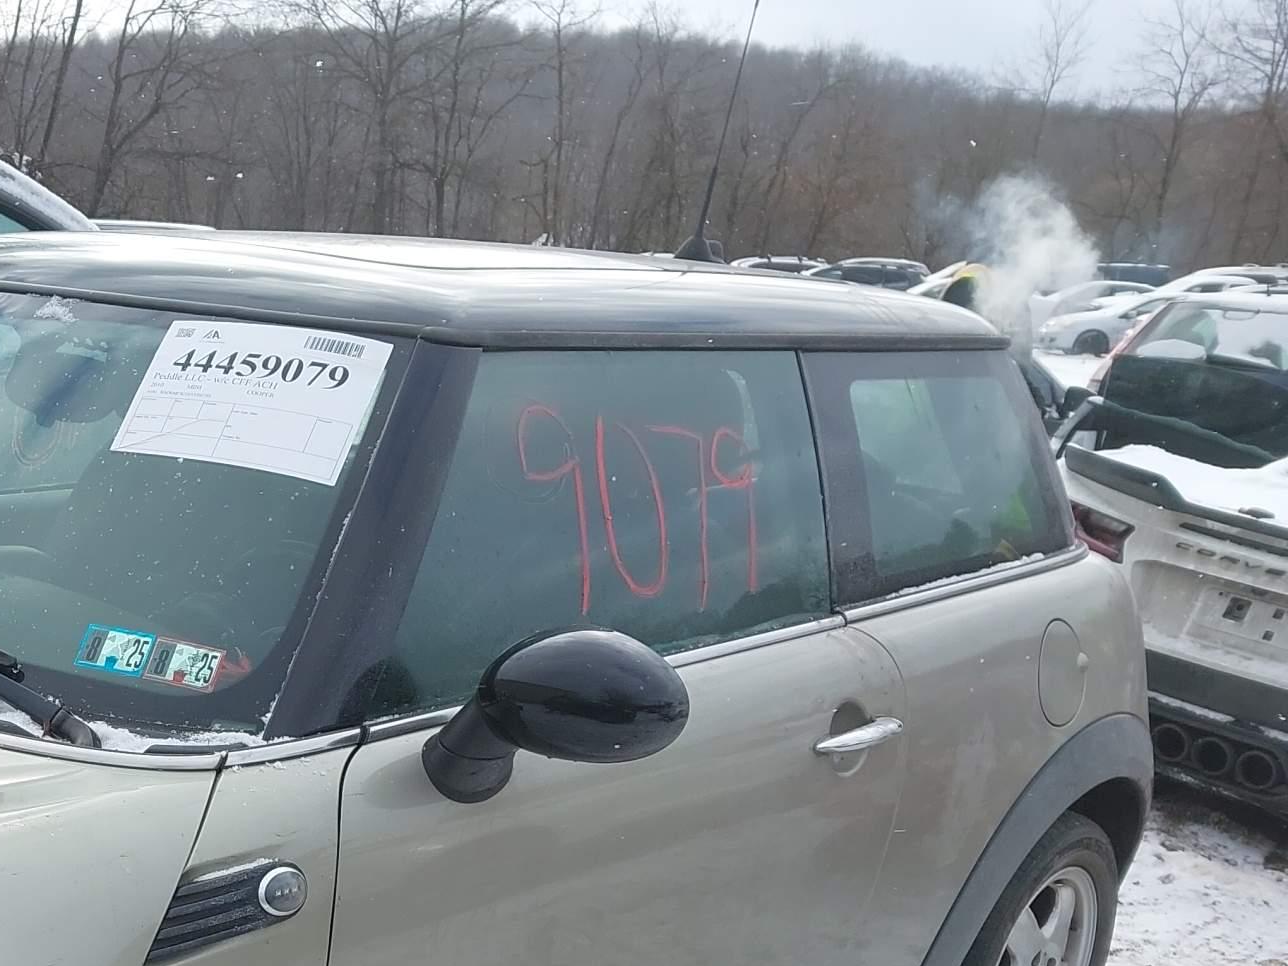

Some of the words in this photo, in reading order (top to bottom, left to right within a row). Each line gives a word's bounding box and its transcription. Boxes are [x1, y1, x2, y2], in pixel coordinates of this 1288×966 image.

[173, 348, 350, 390] 44459079
[517, 403, 759, 616] 9079
[125, 638, 150, 670] 25
[193, 652, 219, 684] 25
